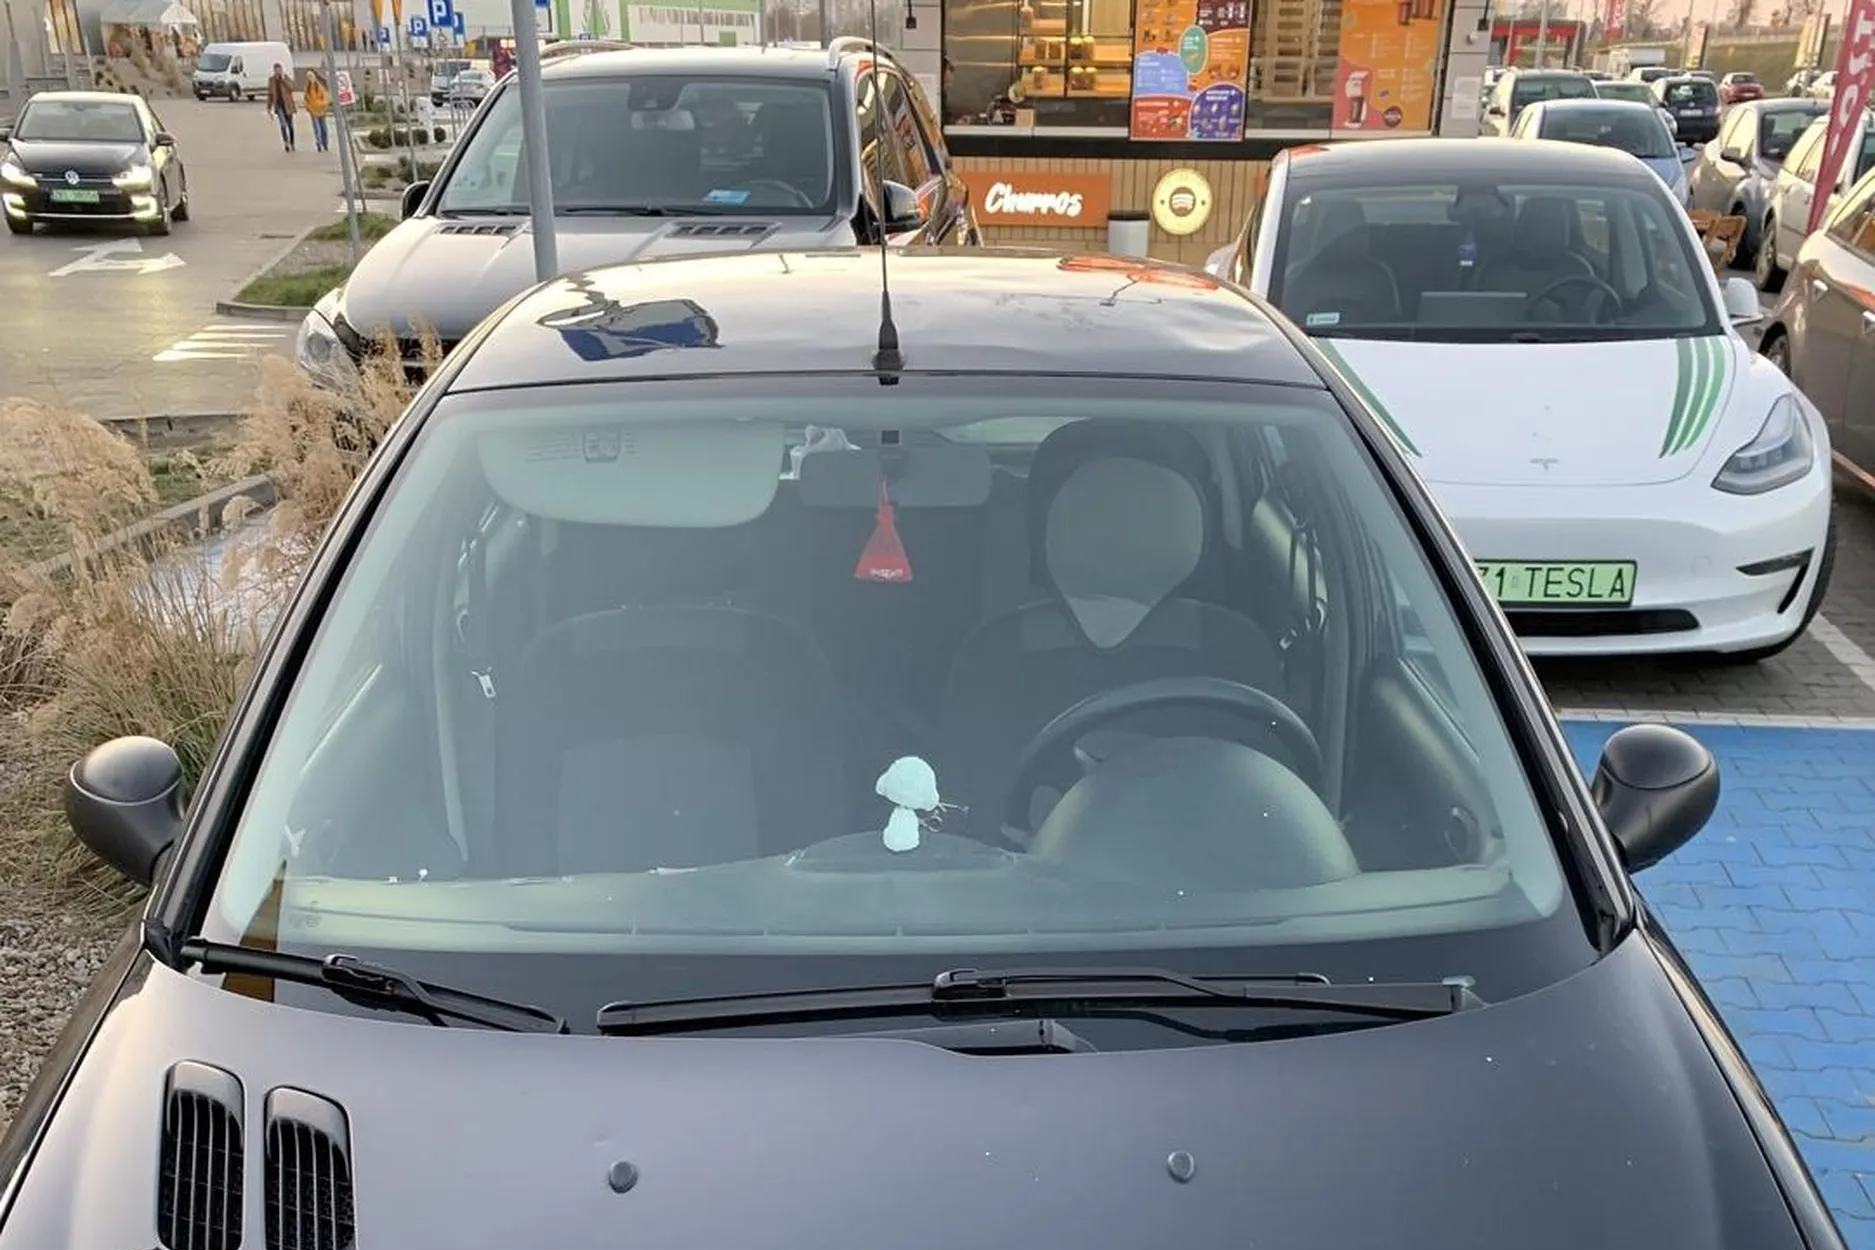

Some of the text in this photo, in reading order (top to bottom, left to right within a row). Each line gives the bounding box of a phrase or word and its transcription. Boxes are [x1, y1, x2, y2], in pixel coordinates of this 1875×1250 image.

[432, 0, 447, 23] P
[984, 182, 1084, 217] Churros
[1524, 566, 1626, 598] TESLA
